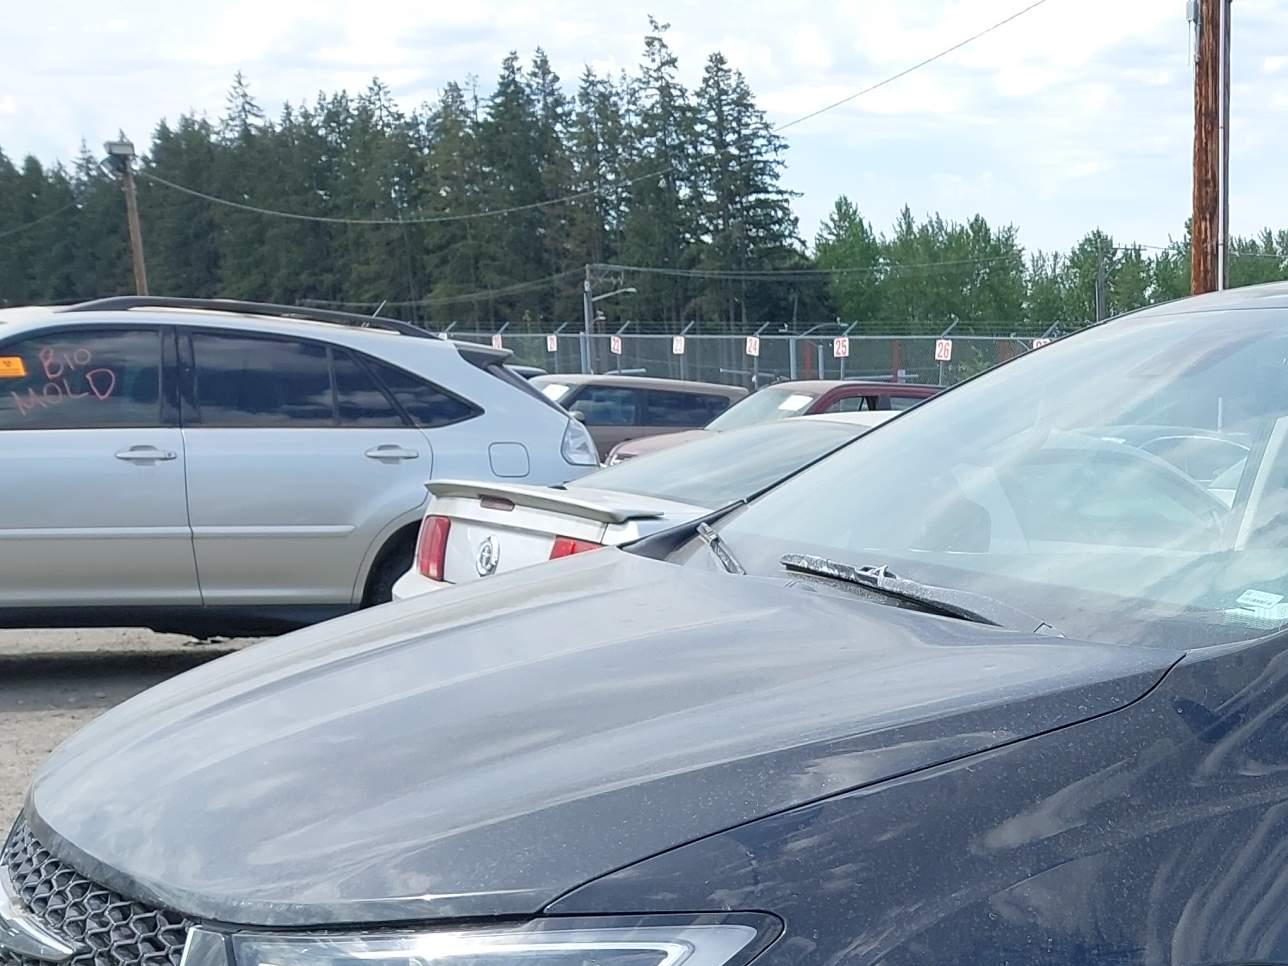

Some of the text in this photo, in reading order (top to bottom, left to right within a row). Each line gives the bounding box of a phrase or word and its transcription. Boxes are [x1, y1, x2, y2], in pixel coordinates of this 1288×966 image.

[748, 338, 758, 354] 24
[835, 339, 848, 355] 25
[938, 341, 950, 358] 26
[11, 368, 116, 416] MOLD
